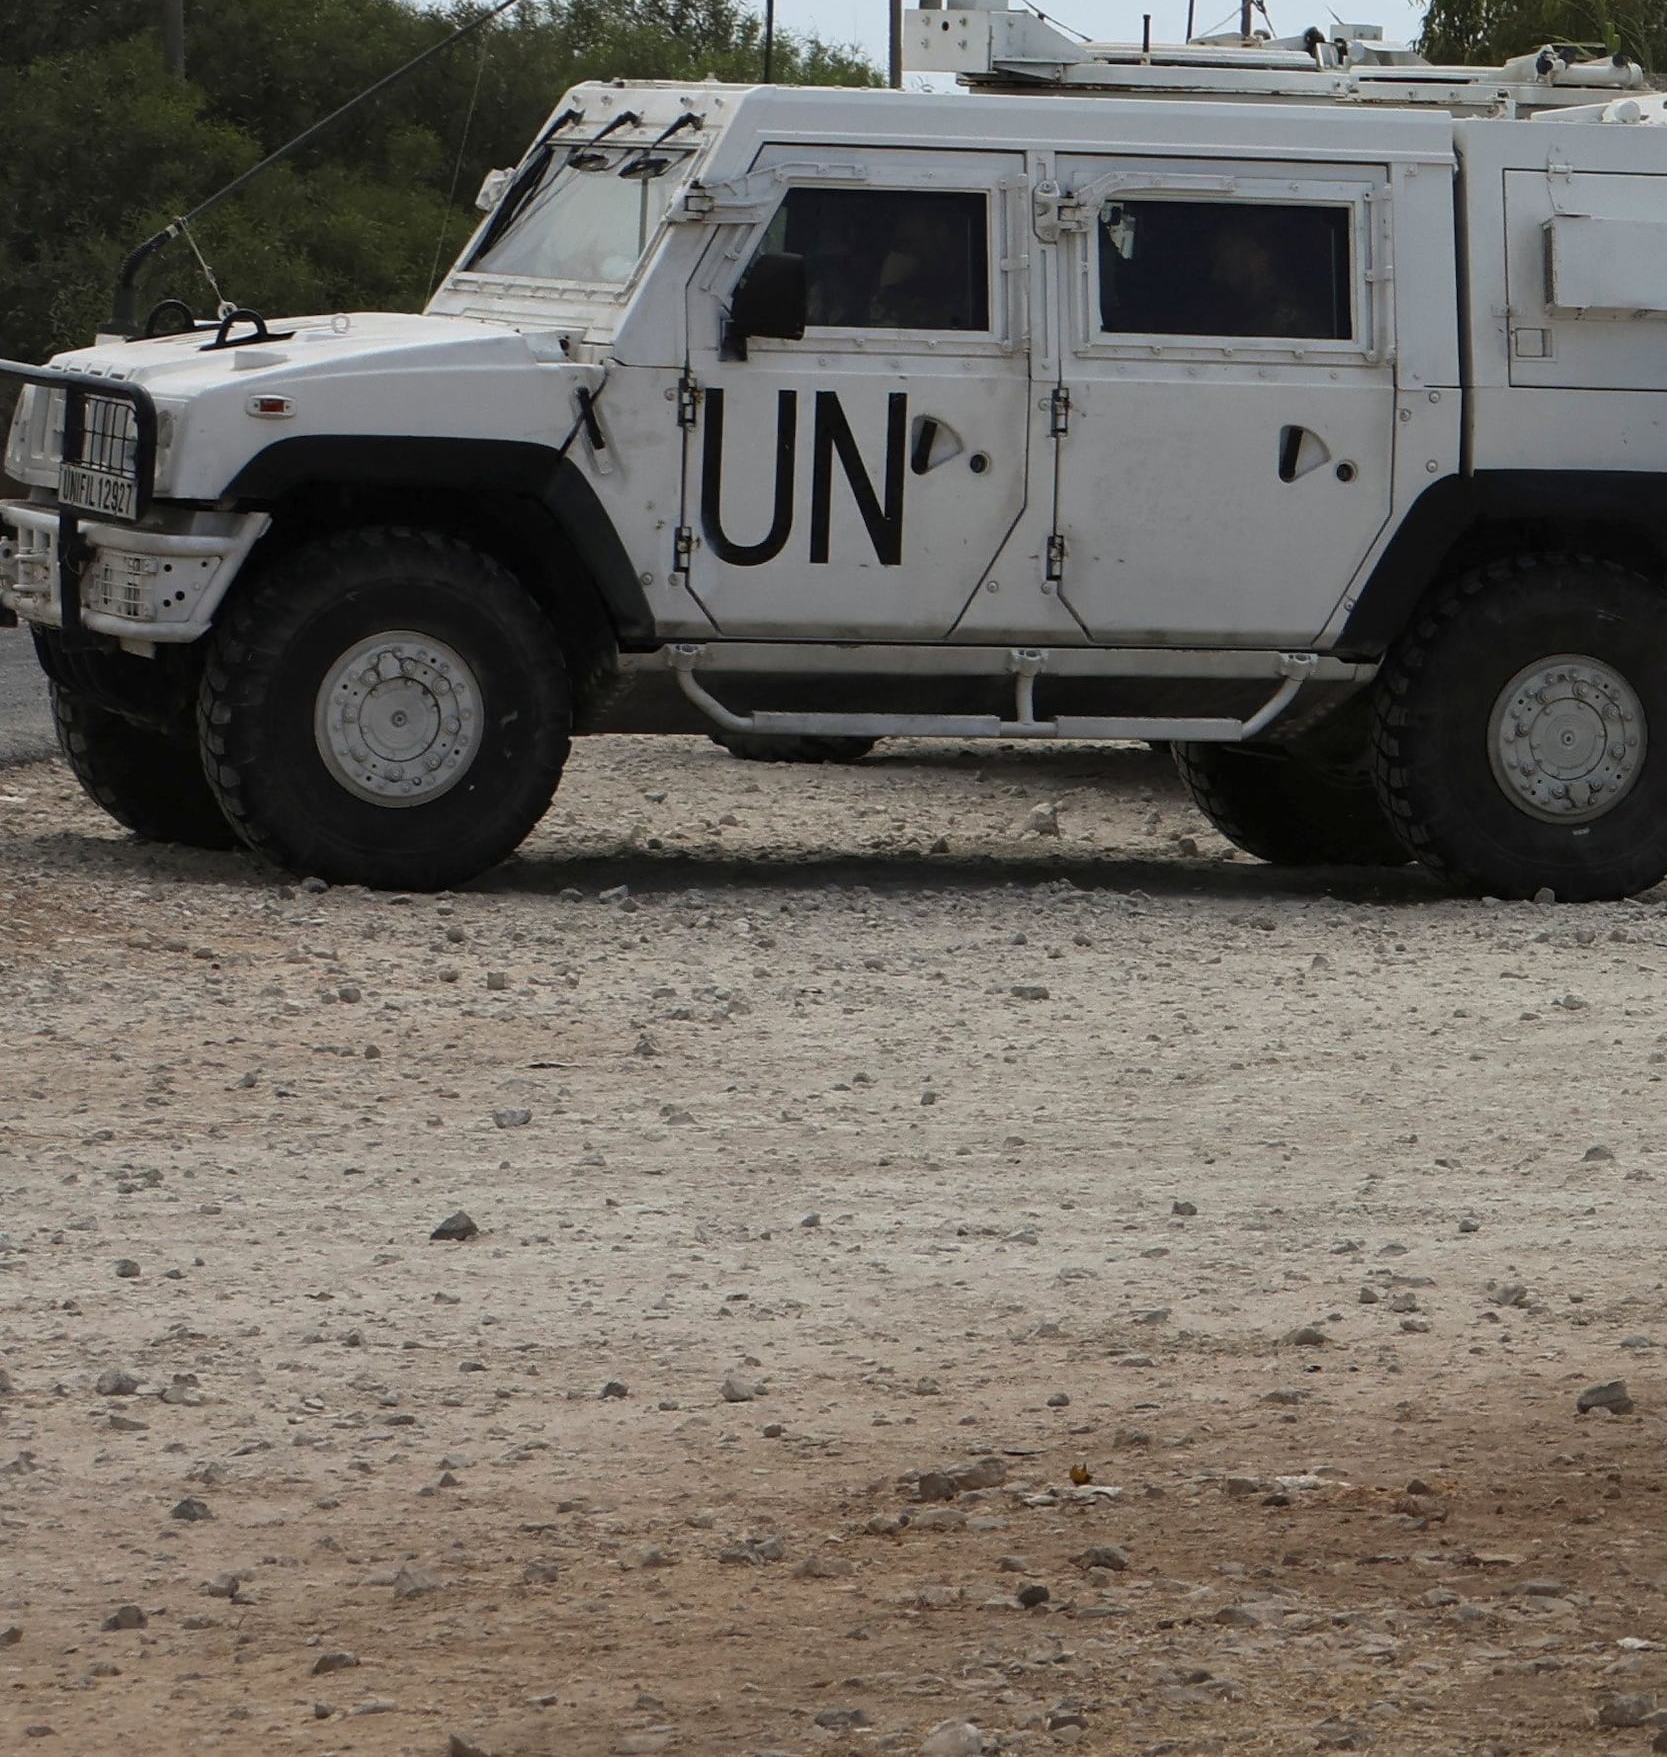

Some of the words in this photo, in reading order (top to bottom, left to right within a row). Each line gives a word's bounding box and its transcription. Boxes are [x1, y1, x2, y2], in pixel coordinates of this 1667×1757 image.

[63, 467, 95, 507] UNIFIL
[97, 477, 133, 516] 12927
[701, 388, 907, 566] UN
